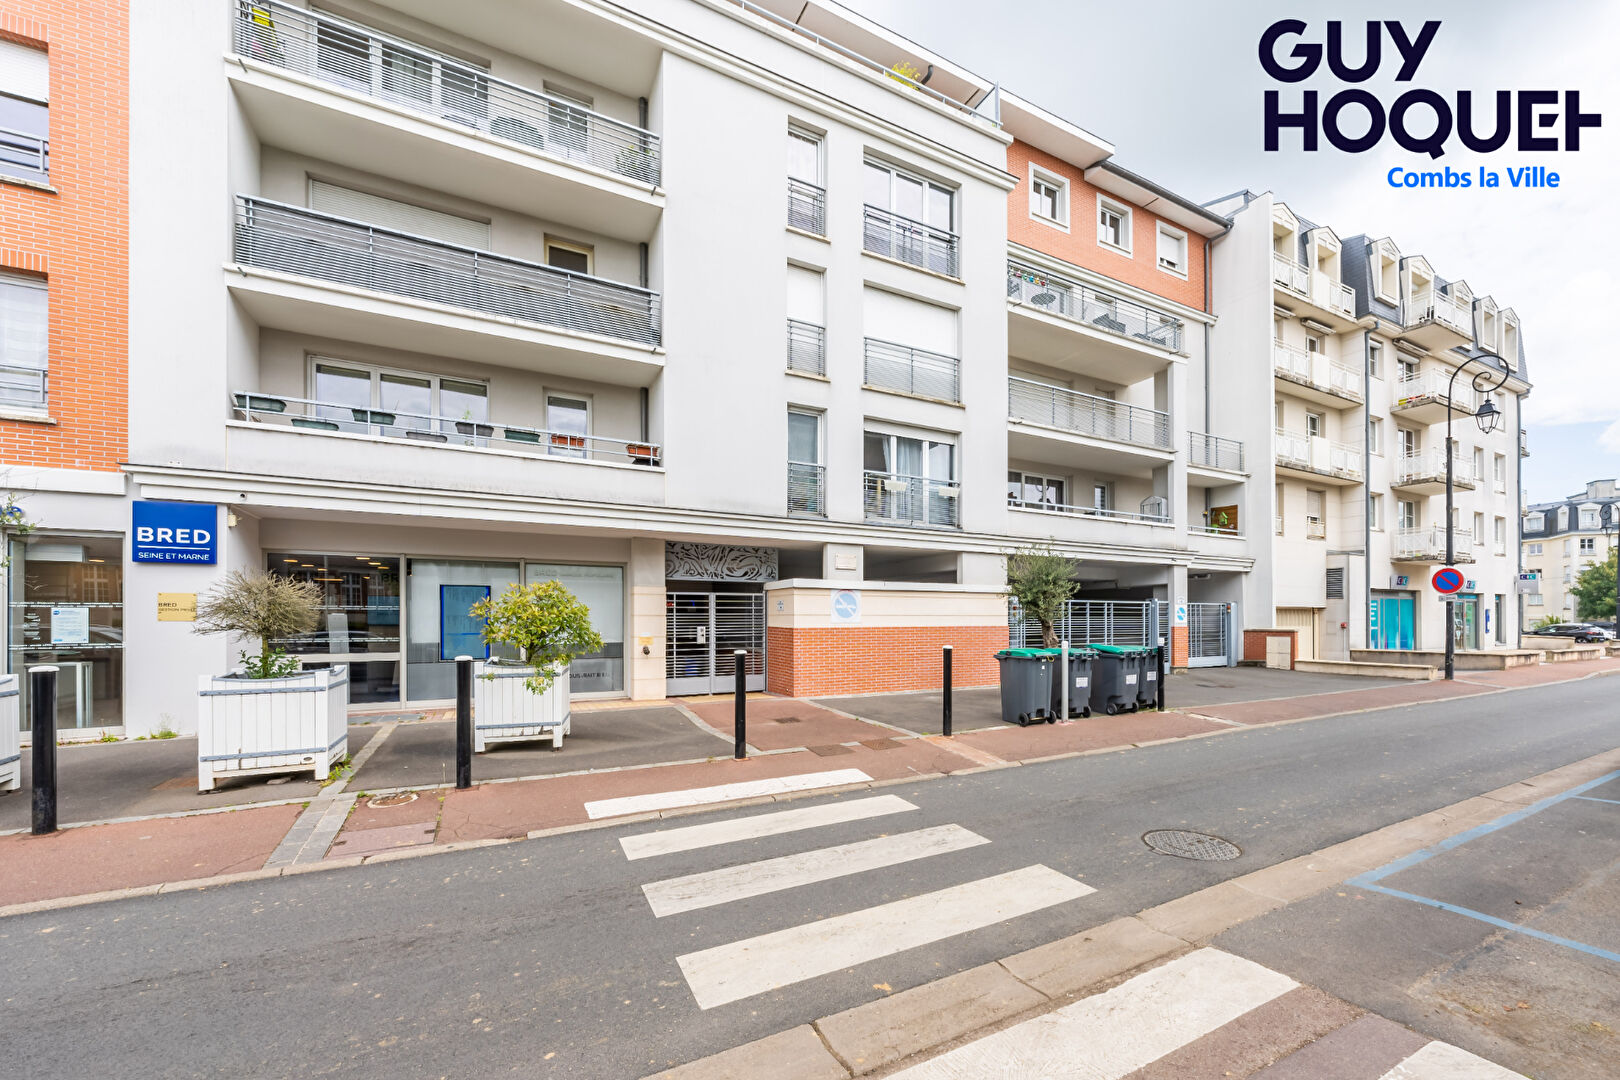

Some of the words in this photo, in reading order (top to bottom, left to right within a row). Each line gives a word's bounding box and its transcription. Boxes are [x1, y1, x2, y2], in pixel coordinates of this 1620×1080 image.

[137, 526, 211, 545] BRED
[138, 551, 164, 560] SEINE
[178, 553, 210, 561] MARNE
